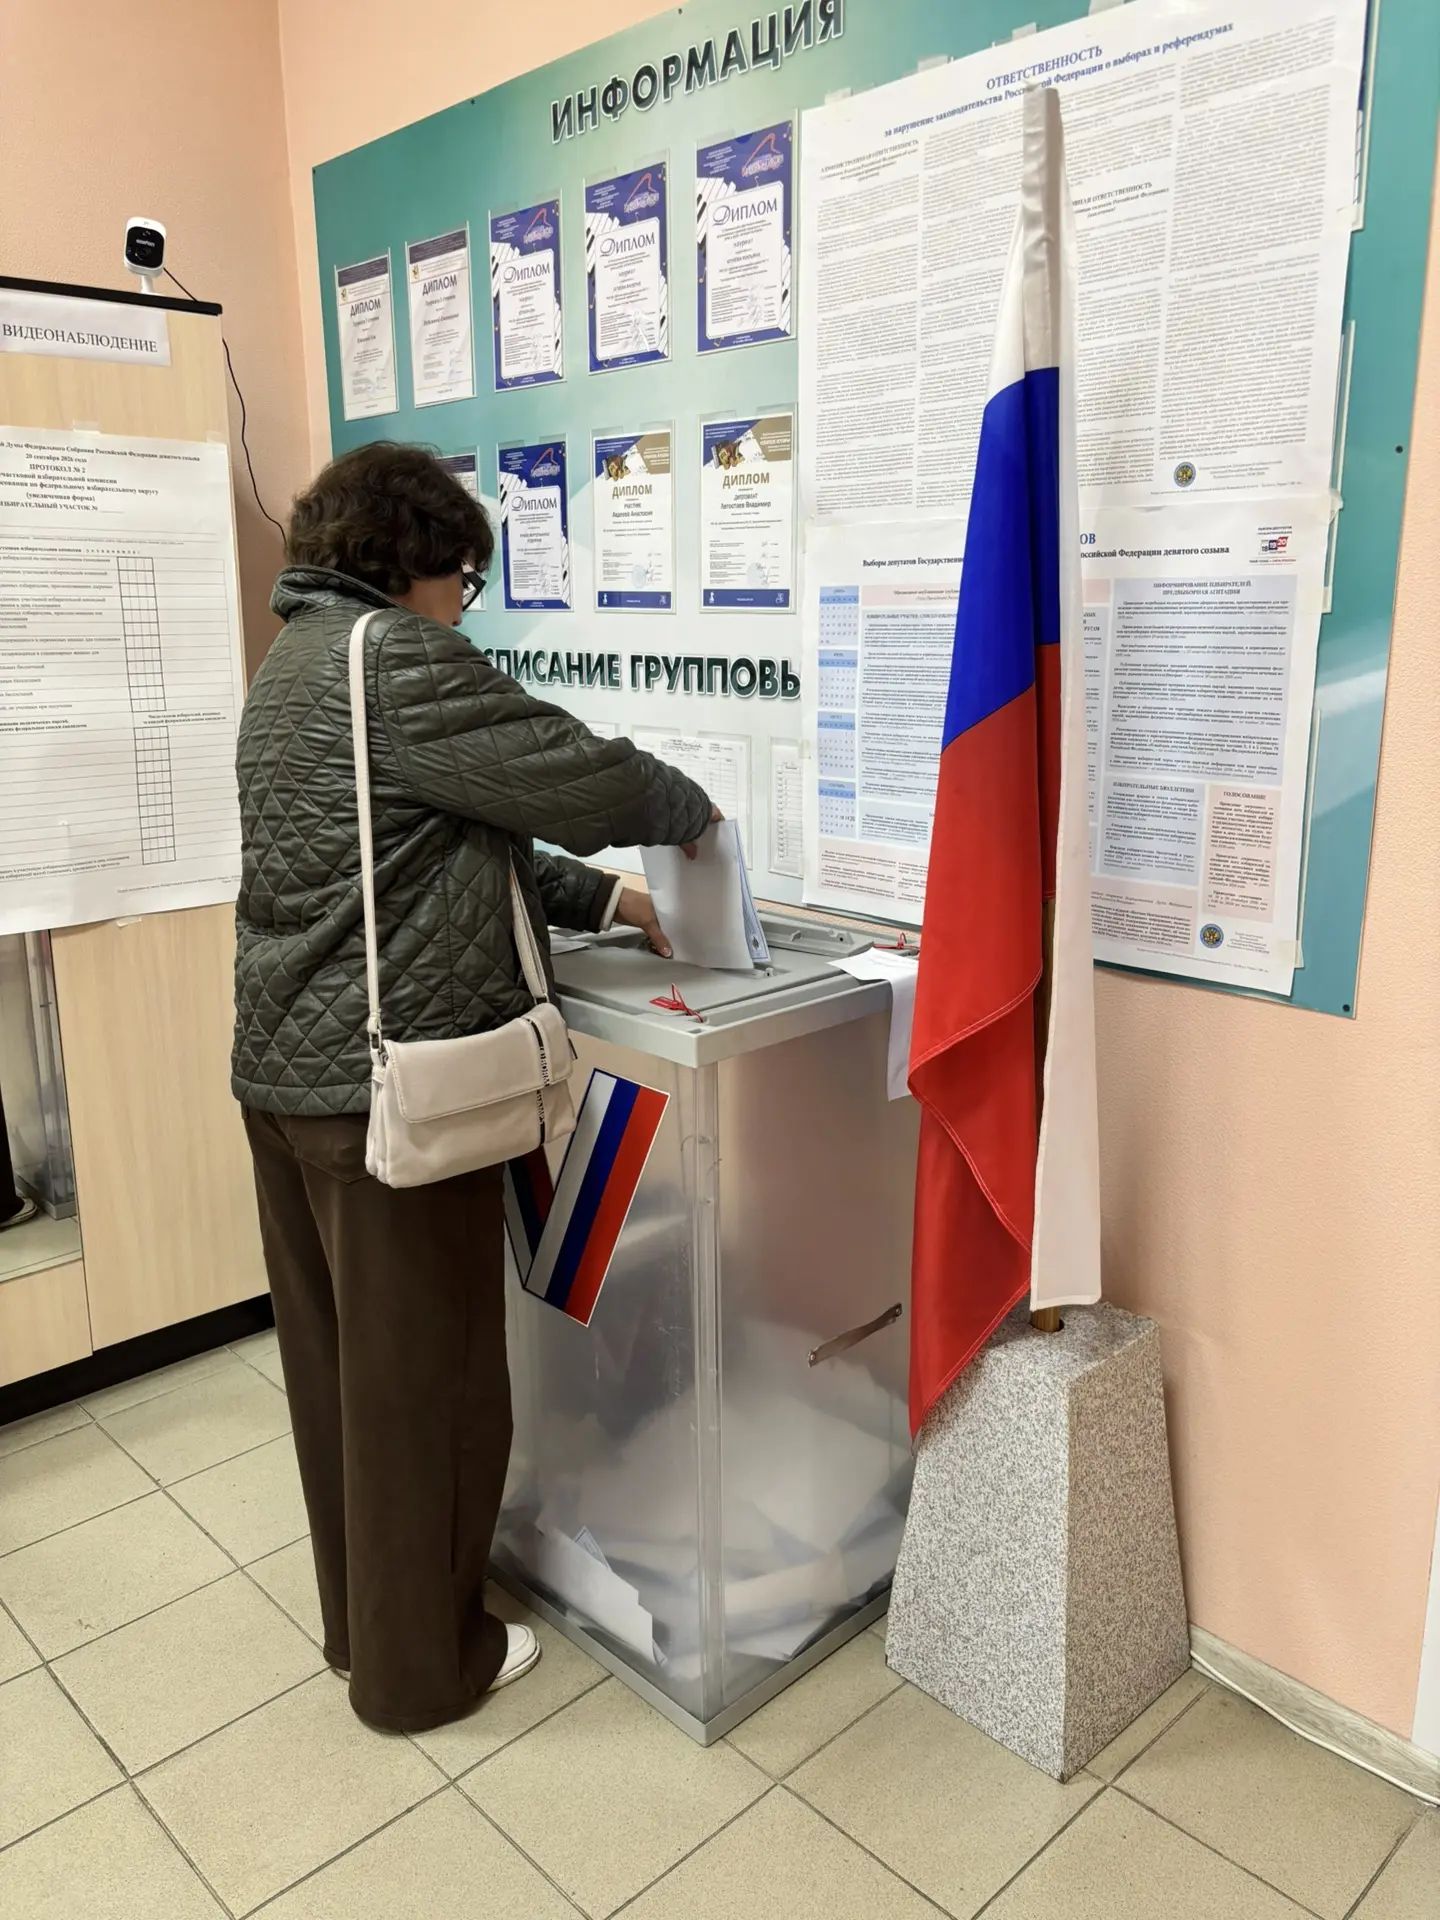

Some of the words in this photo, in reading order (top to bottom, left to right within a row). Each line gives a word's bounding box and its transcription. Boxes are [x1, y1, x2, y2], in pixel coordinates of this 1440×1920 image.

[552, 0, 844, 143] ИНФОРМАЦИЯ
[986, 45, 1102, 90] ОТВЕТСТВЕННОСТЬ
[893, 116, 934, 134] нарушение
[936, 94, 1003, 121] законодательства
[1054, 64, 1103, 83] Федерации
[1105, 61, 1111, 69] о
[1113, 49, 1152, 68] выборах
[1154, 45, 1160, 53] и
[1162, 23, 1233, 54] референдумах
[712, 198, 777, 226] ДИПЛОМ
[600, 232, 655, 257] ДИПЛОМ
[503, 261, 550, 283] ДИПЛОМ
[422, 274, 458, 296] ДИПЛОМ
[350, 298, 381, 317] ДИПЛОМ
[2, 324, 158, 353] ВИДЕОНАБЛЮДЕНИЕ
[29, 463, 71, 472] ПРОТОКОЛ
[723, 472, 769, 489] ДИПЛОМ
[612, 485, 652, 500] ДИПЛОМ
[511, 496, 558, 511] ДИПЛОМ
[1079, 533, 1096, 544] ОВ
[1081, 549, 1117, 558] оссийской
[1118, 549, 1161, 558] Федерации
[1163, 548, 1199, 556] девятого
[863, 559, 886, 568] Выборы
[887, 559, 916, 567] депутатов
